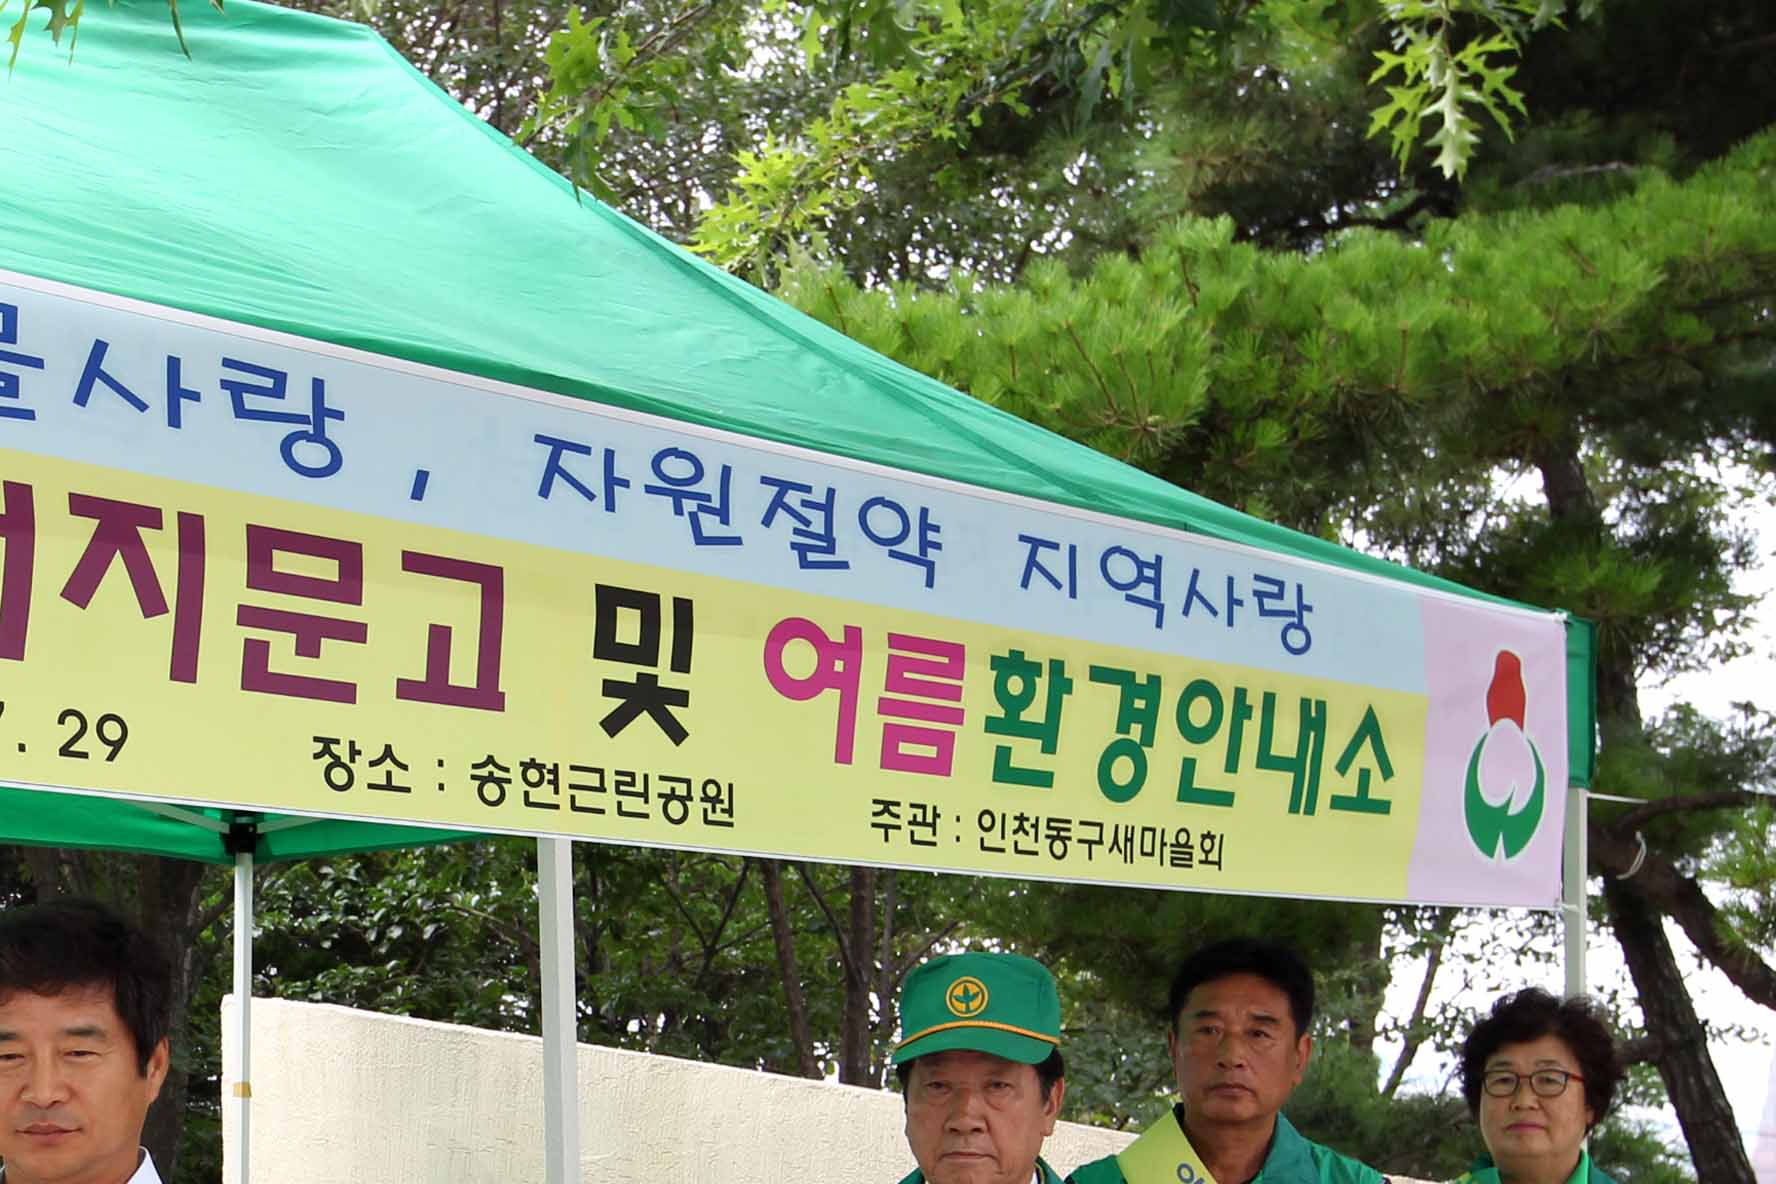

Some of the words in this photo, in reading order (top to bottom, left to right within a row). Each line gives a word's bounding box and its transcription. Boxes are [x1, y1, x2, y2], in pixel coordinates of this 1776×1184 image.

[533, 433, 943, 588] 자원절약
[1019, 533, 1314, 656] 지역사랑
[594, 582, 694, 747] 및
[57, 709, 130, 764] 29
[311, 736, 412, 795] 장소
[469, 754, 736, 828] 송현근린공원
[870, 798, 940, 849] 주관
[977, 808, 1225, 872] 인천동구새마을회
